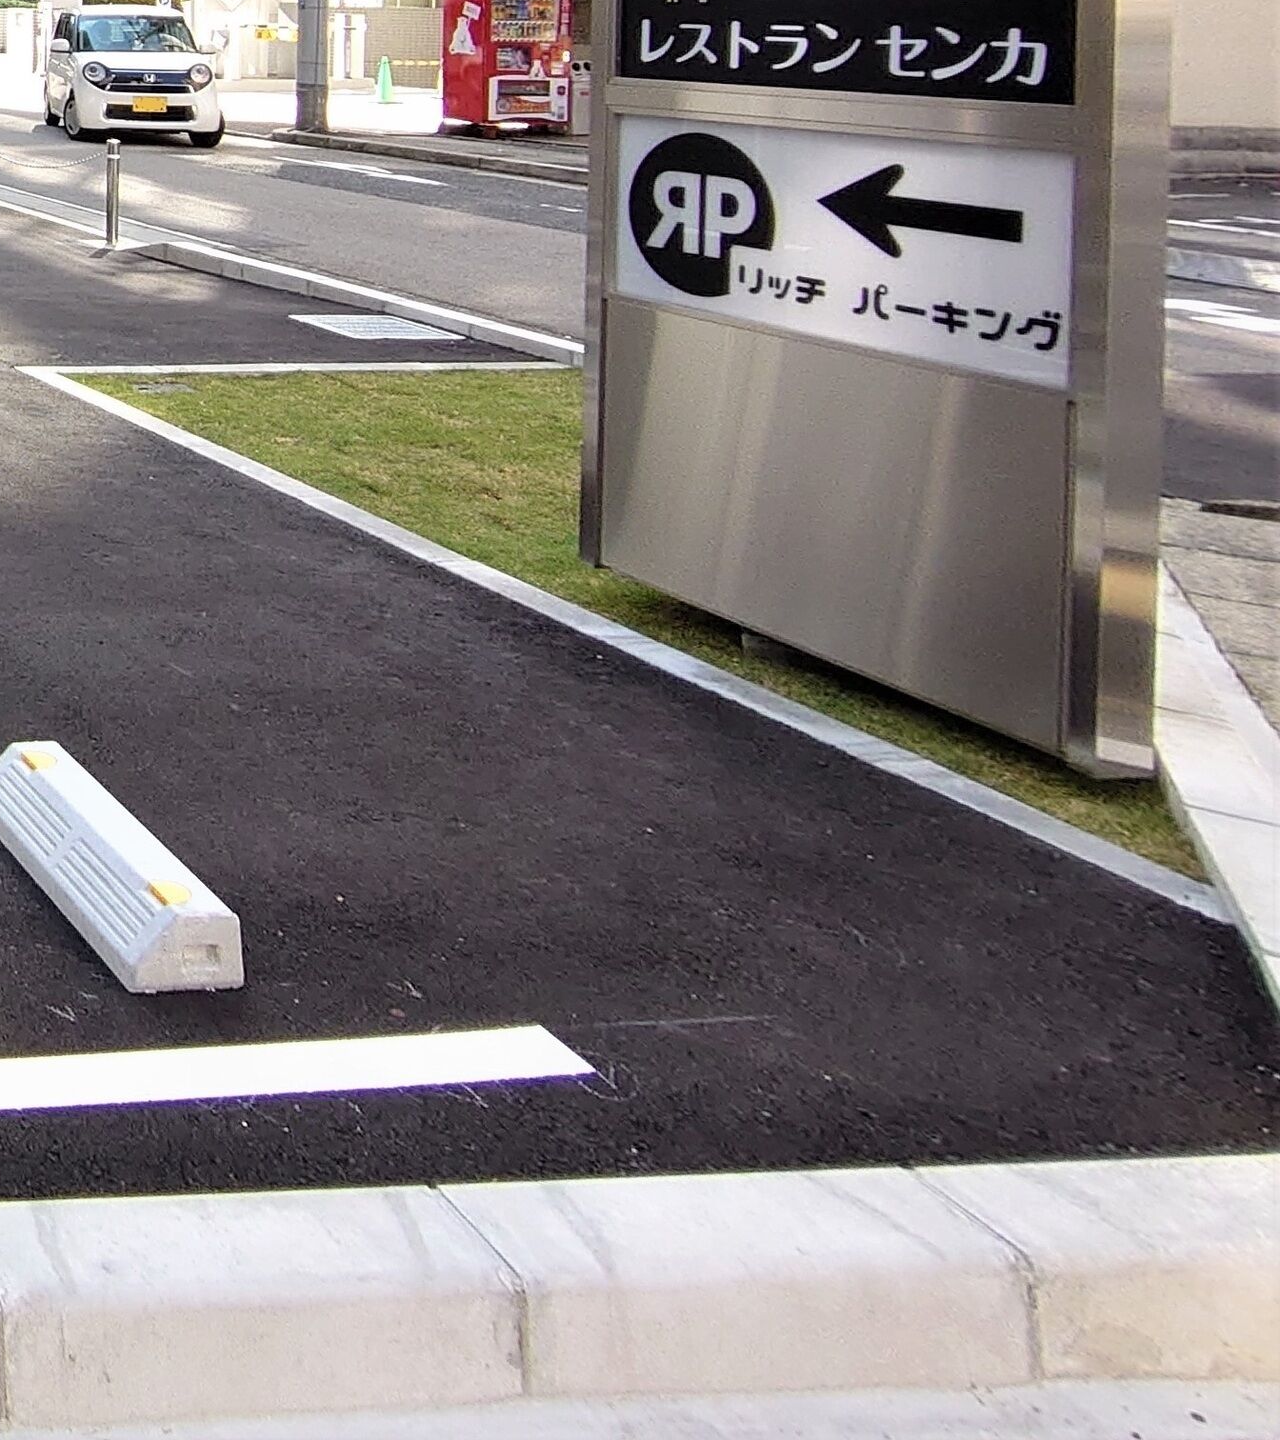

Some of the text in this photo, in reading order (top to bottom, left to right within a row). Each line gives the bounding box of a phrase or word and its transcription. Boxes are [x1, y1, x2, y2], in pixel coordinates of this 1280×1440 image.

[640, 18, 1048, 86] レストラン センカ
[738, 265, 1063, 352] リッチ パーキング
